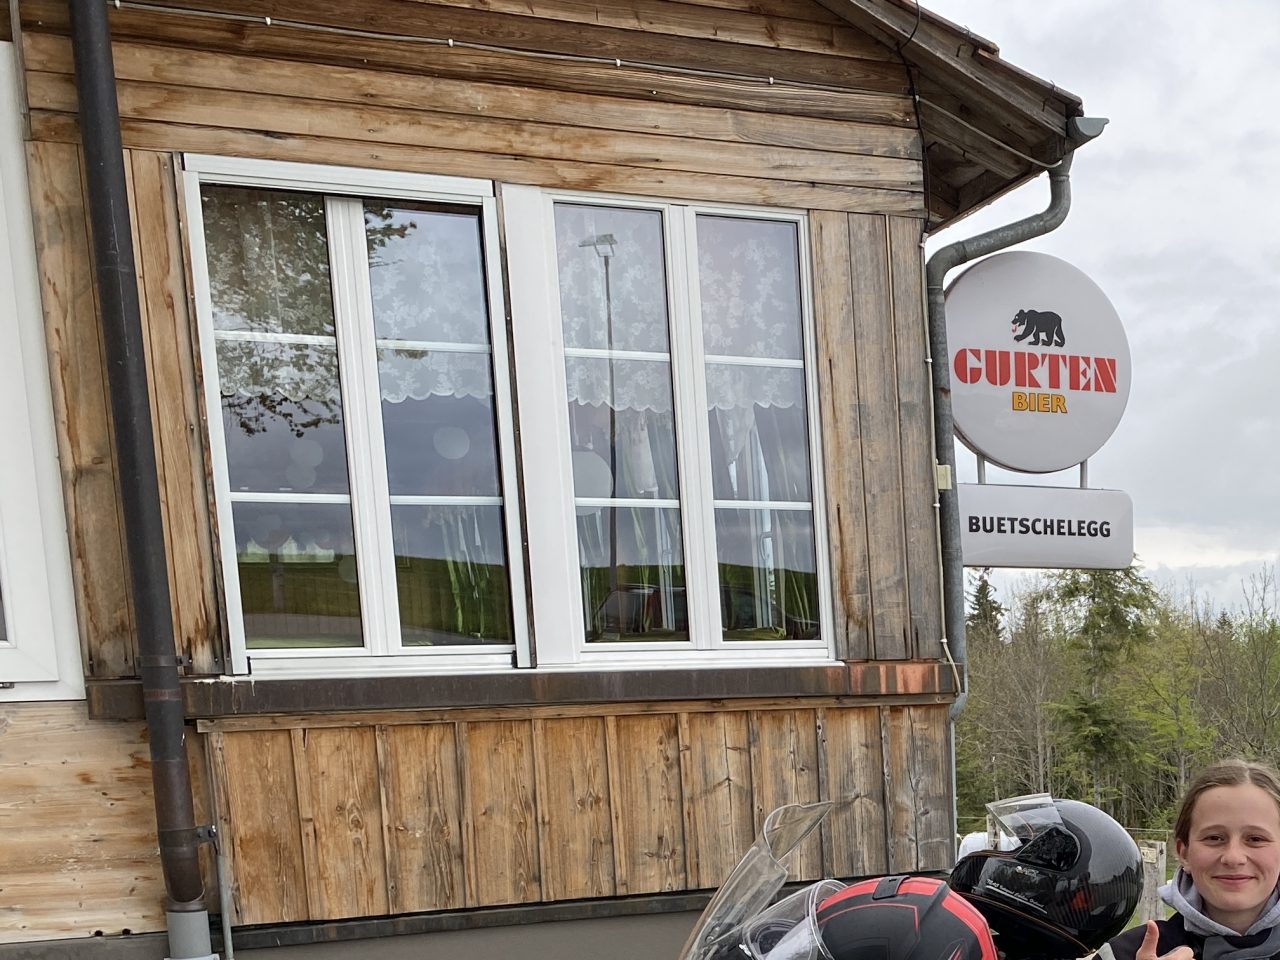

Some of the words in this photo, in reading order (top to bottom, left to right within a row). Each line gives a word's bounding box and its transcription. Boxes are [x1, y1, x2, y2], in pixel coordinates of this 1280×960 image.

[953, 348, 1117, 393] GURTEN
[1012, 391, 1068, 414] BIER
[968, 515, 1111, 538] BUETSCHELEGG
